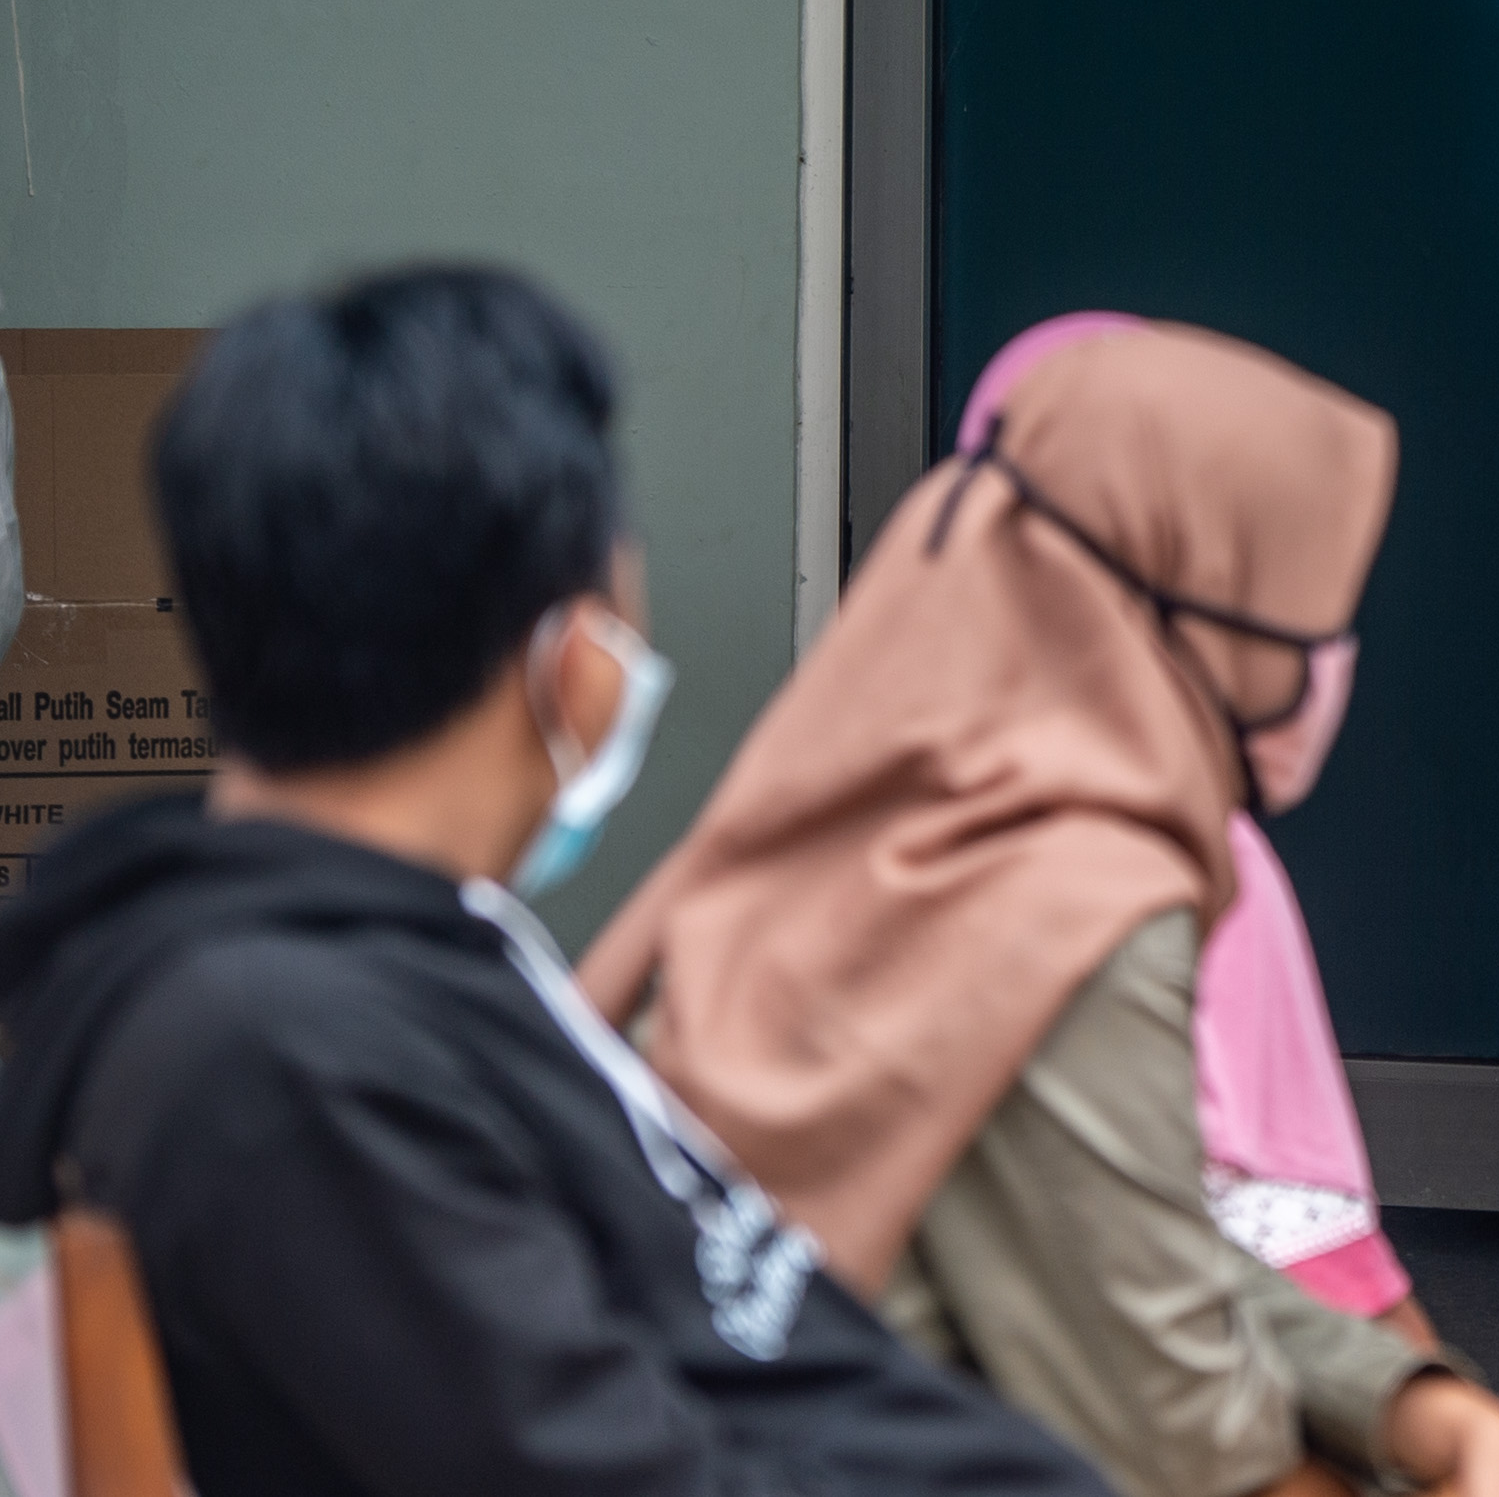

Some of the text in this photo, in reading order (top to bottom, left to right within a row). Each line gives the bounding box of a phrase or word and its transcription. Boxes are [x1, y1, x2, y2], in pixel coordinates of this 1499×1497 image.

[34, 690, 94, 720] Putih
[106, 690, 169, 720] Seam
[181, 690, 212, 720] Ta
[59, 733, 116, 767] putih
[0, 804, 64, 825] HITE
